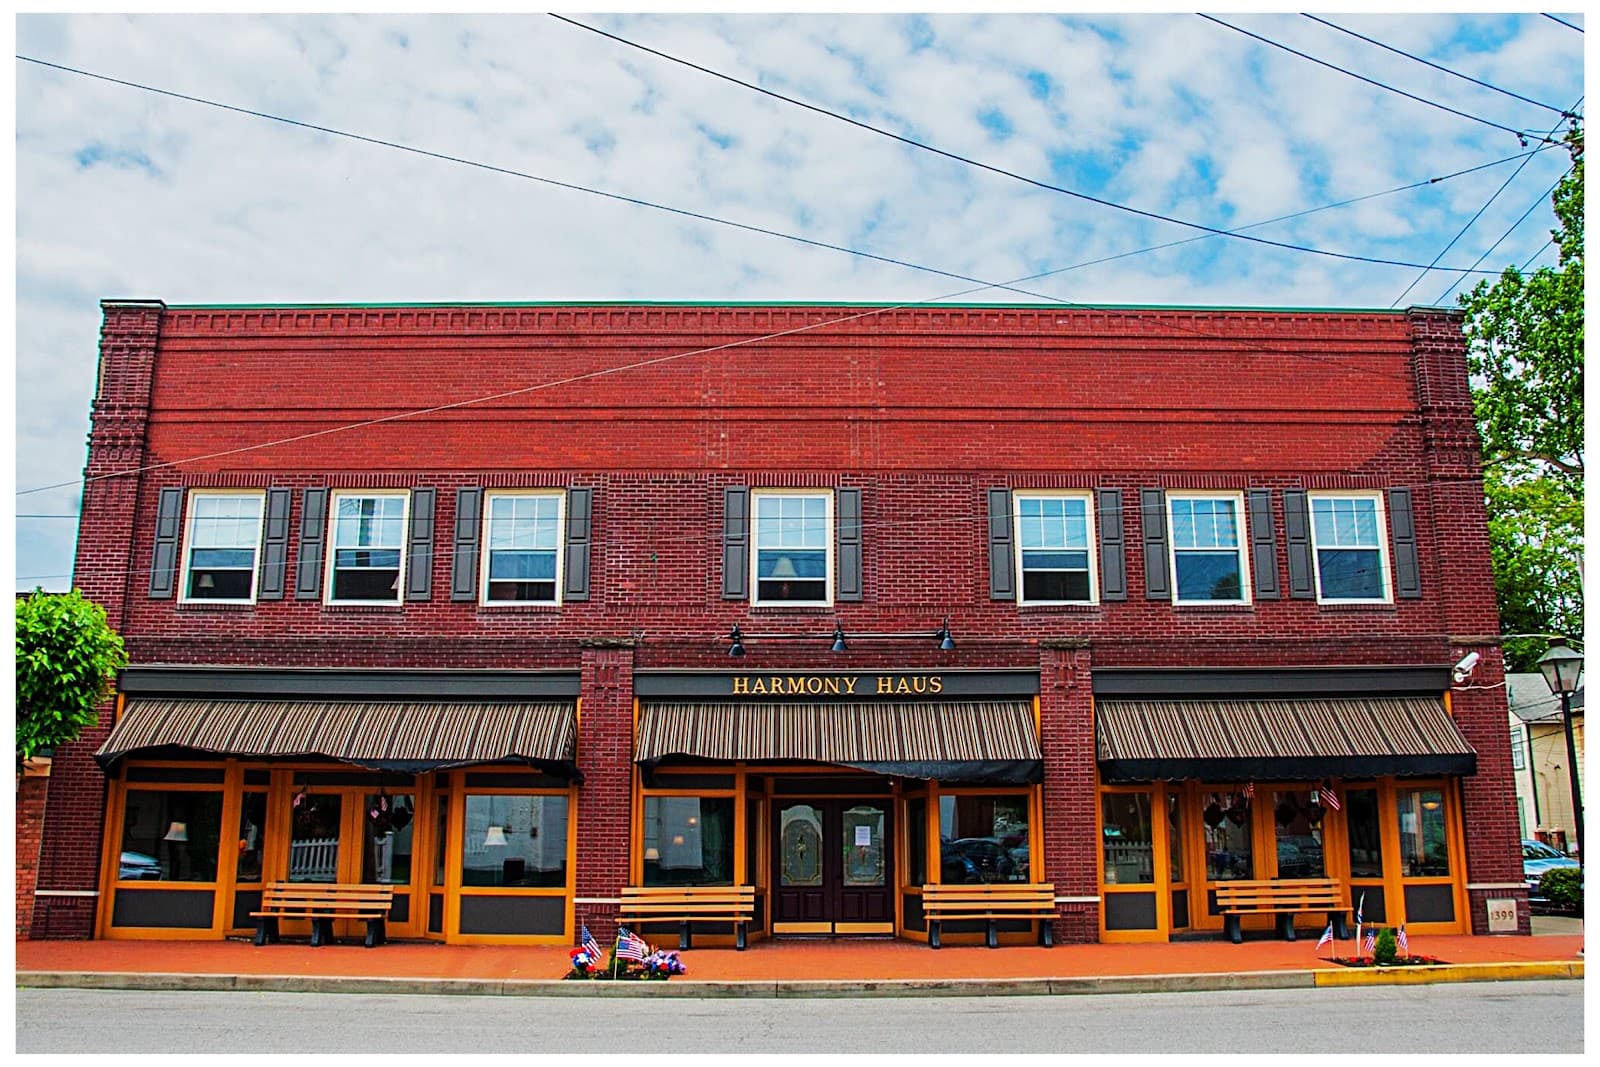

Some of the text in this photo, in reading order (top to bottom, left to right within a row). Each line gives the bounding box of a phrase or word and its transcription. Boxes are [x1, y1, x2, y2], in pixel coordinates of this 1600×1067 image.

[733, 676, 943, 694] HARMONY HAUS
[1490, 910, 1514, 920] 1399
